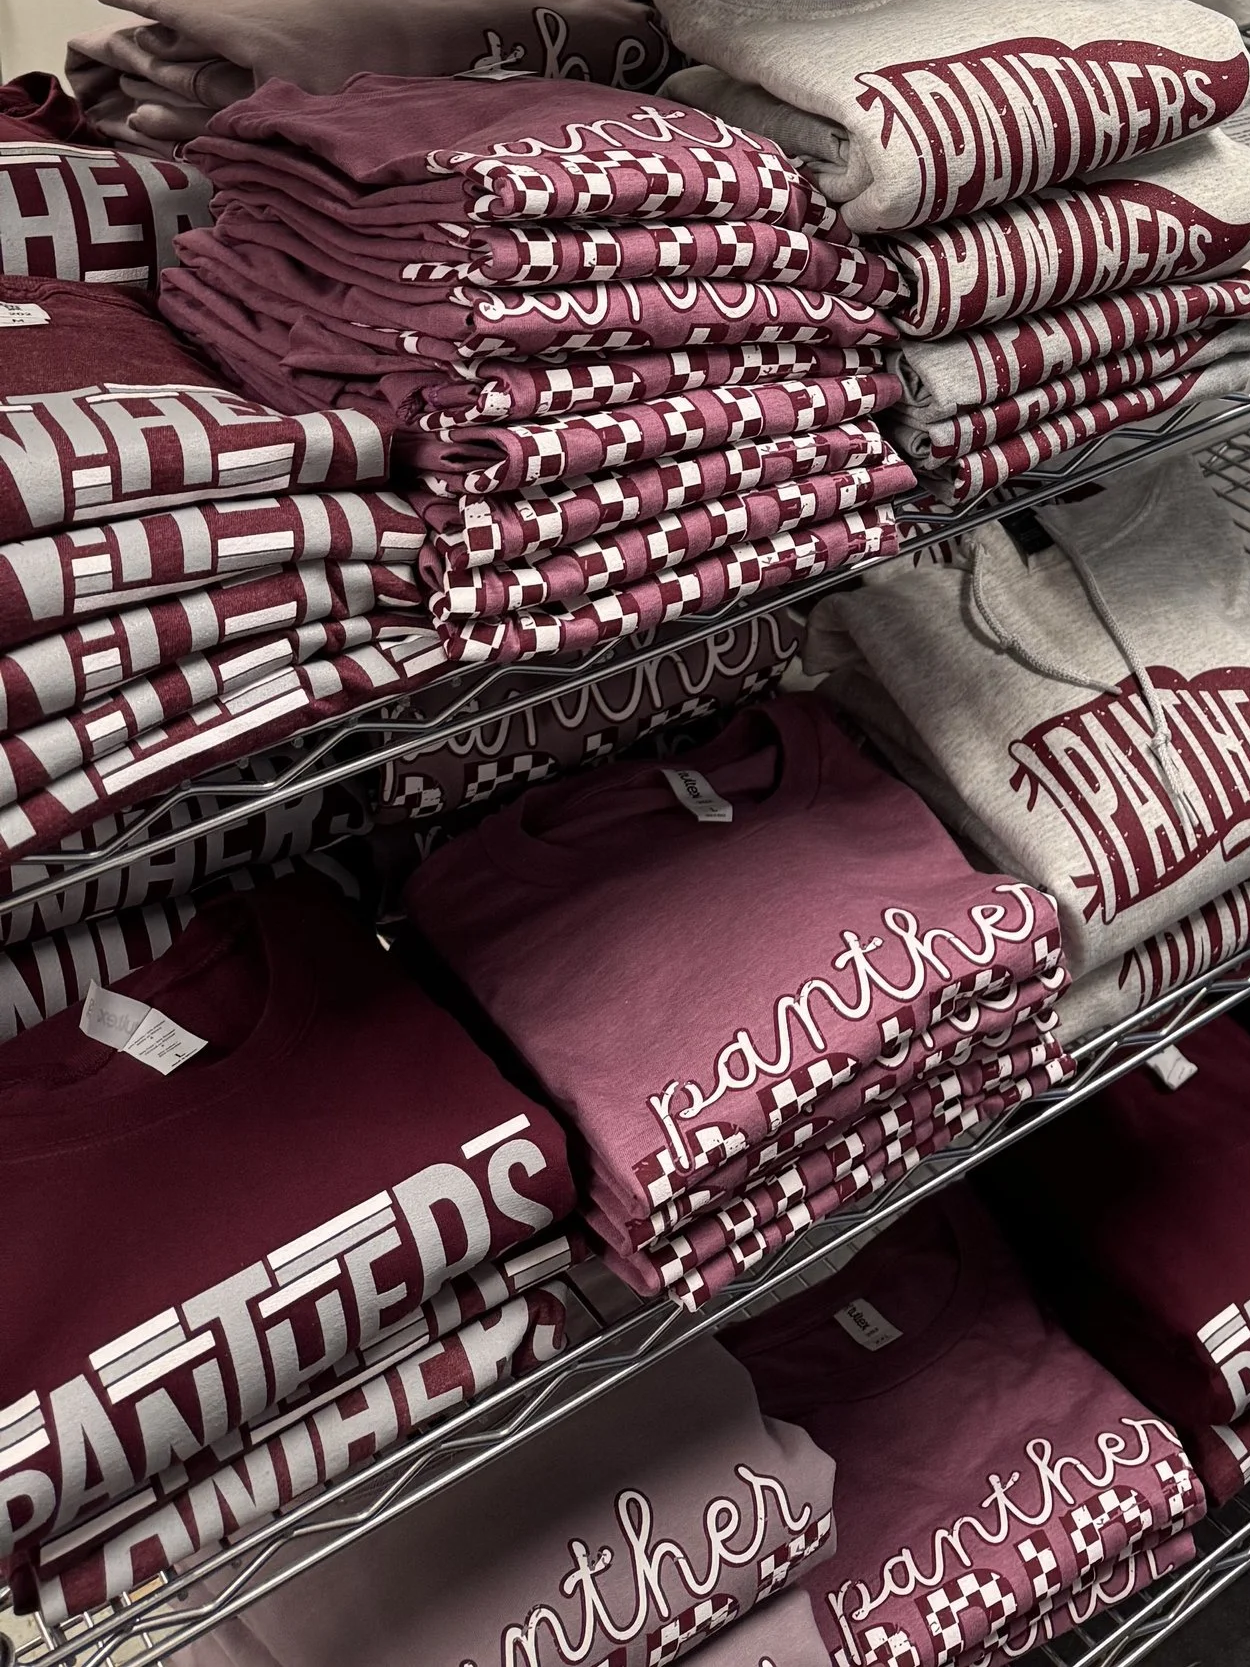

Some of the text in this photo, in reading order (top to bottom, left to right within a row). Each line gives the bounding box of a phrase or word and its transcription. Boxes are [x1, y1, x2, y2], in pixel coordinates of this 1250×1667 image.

[903, 51, 1217, 220] PANTHERS
[646, 881, 1060, 1176] panther
[826, 1414, 1185, 1667] panther
